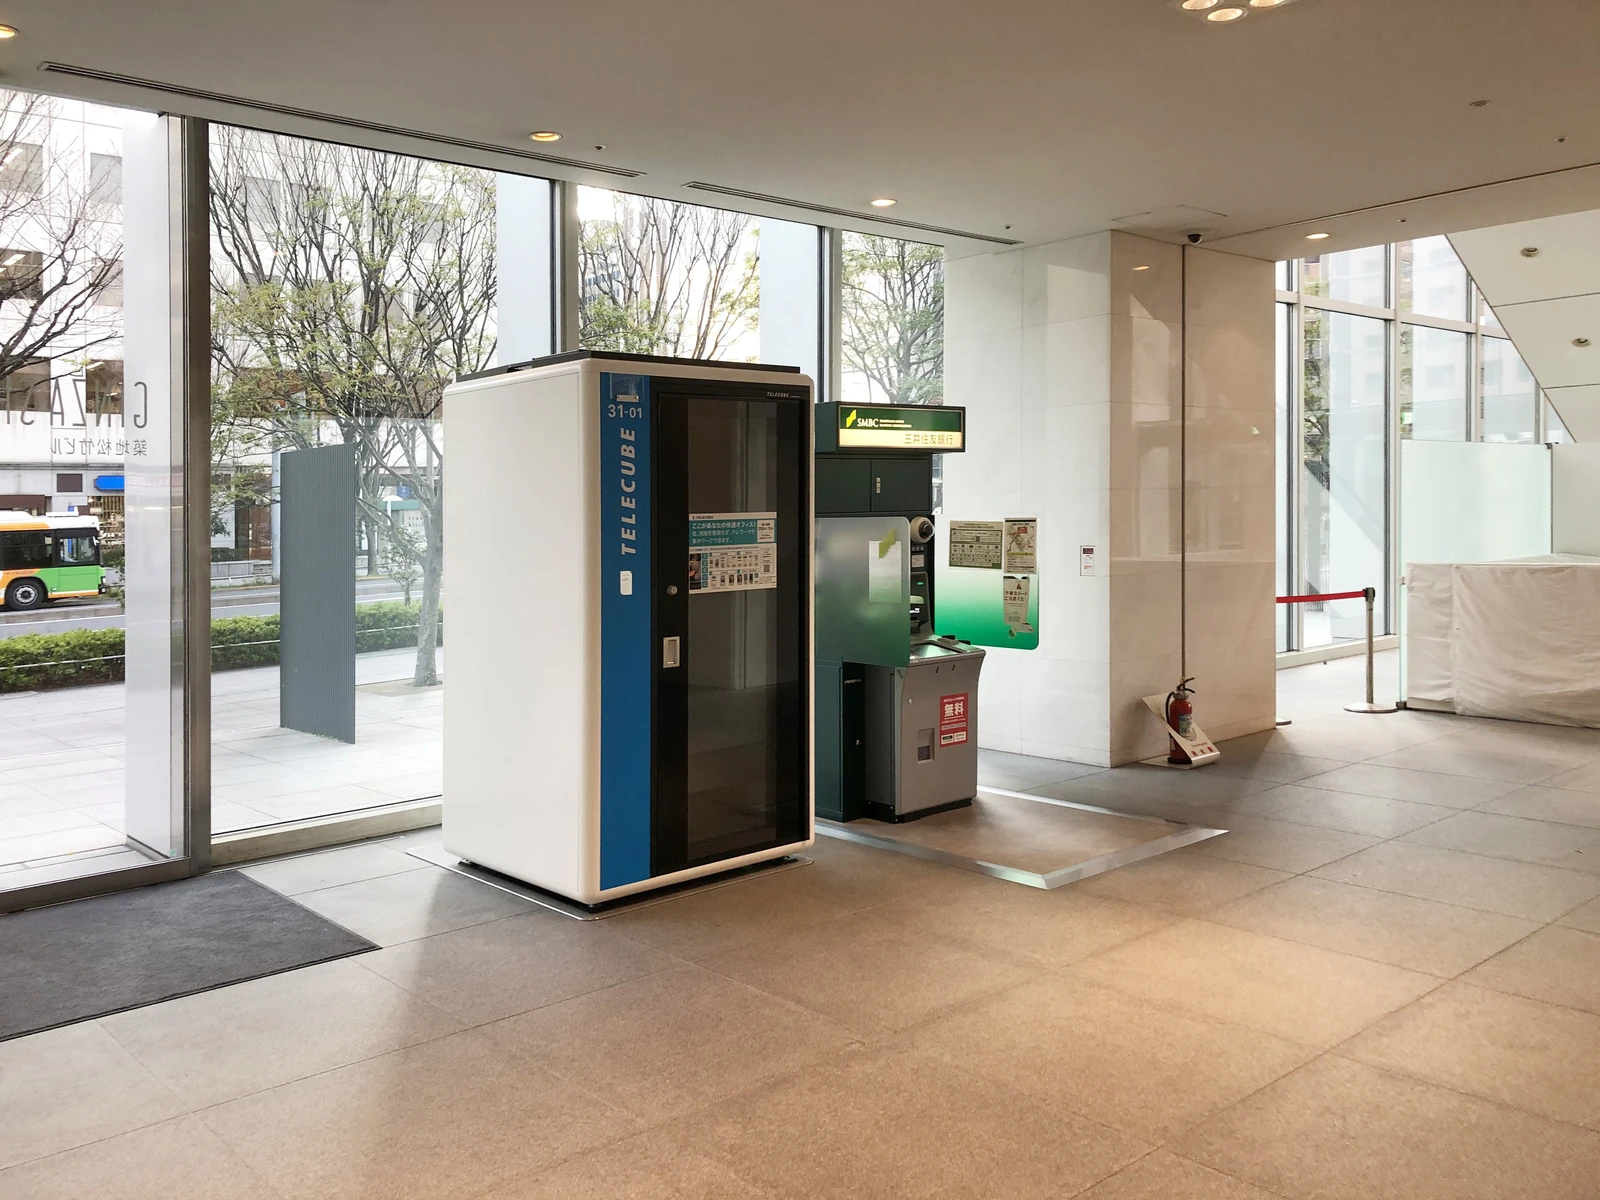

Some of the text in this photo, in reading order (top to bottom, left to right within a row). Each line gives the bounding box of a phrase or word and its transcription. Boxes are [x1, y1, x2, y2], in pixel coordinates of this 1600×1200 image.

[608, 404, 642, 419] 31-01
[857, 418, 879, 427] SMBC
[904, 433, 953, 445] 三井住友銀行
[620, 427, 636, 556] TELECUBE
[944, 701, 964, 717] 無料
